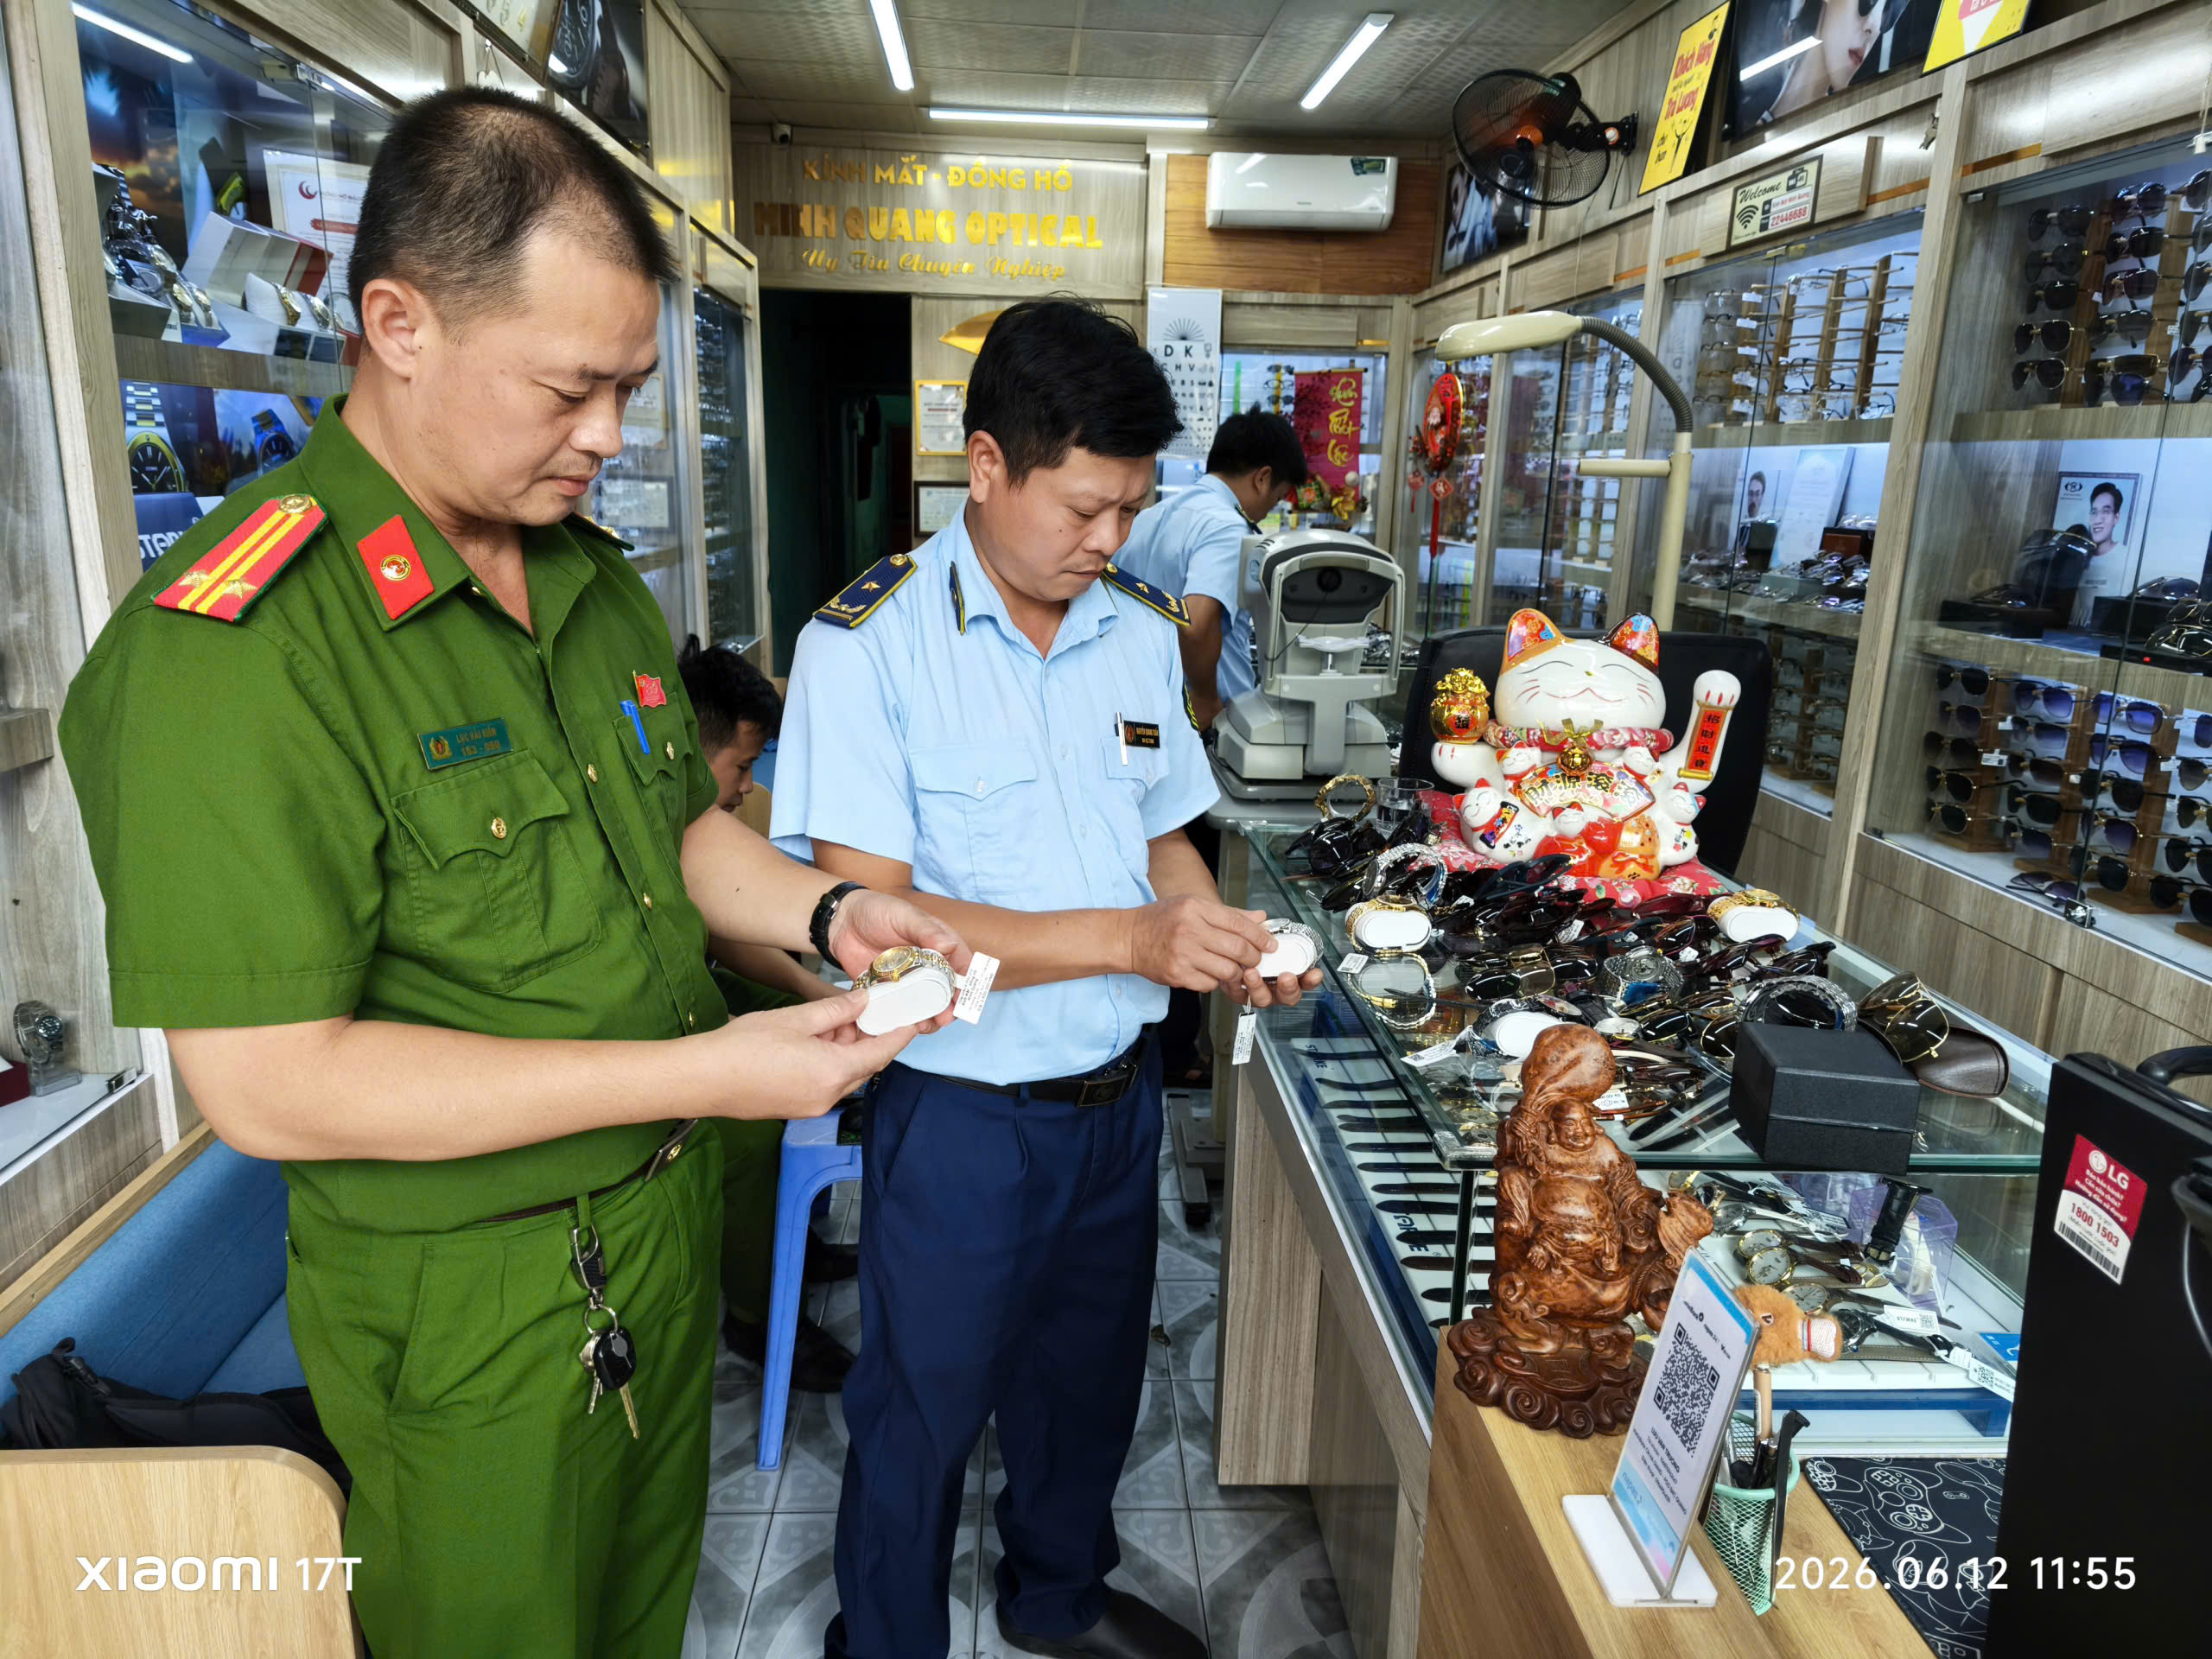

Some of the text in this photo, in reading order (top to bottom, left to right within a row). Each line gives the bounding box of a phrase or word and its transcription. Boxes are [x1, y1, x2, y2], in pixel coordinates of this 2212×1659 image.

[804, 152, 867, 184] KÍNH
[874, 154, 928, 187] MẮT
[1739, 181, 1782, 204] Welcome
[753, 201, 1103, 250] MINH QUANG OPTICAL
[1164, 345, 1192, 358] D K
[2108, 1165, 2129, 1190] LG
[2070, 1202, 2094, 1228] 1800
[2096, 1222, 2120, 1248] 1503
